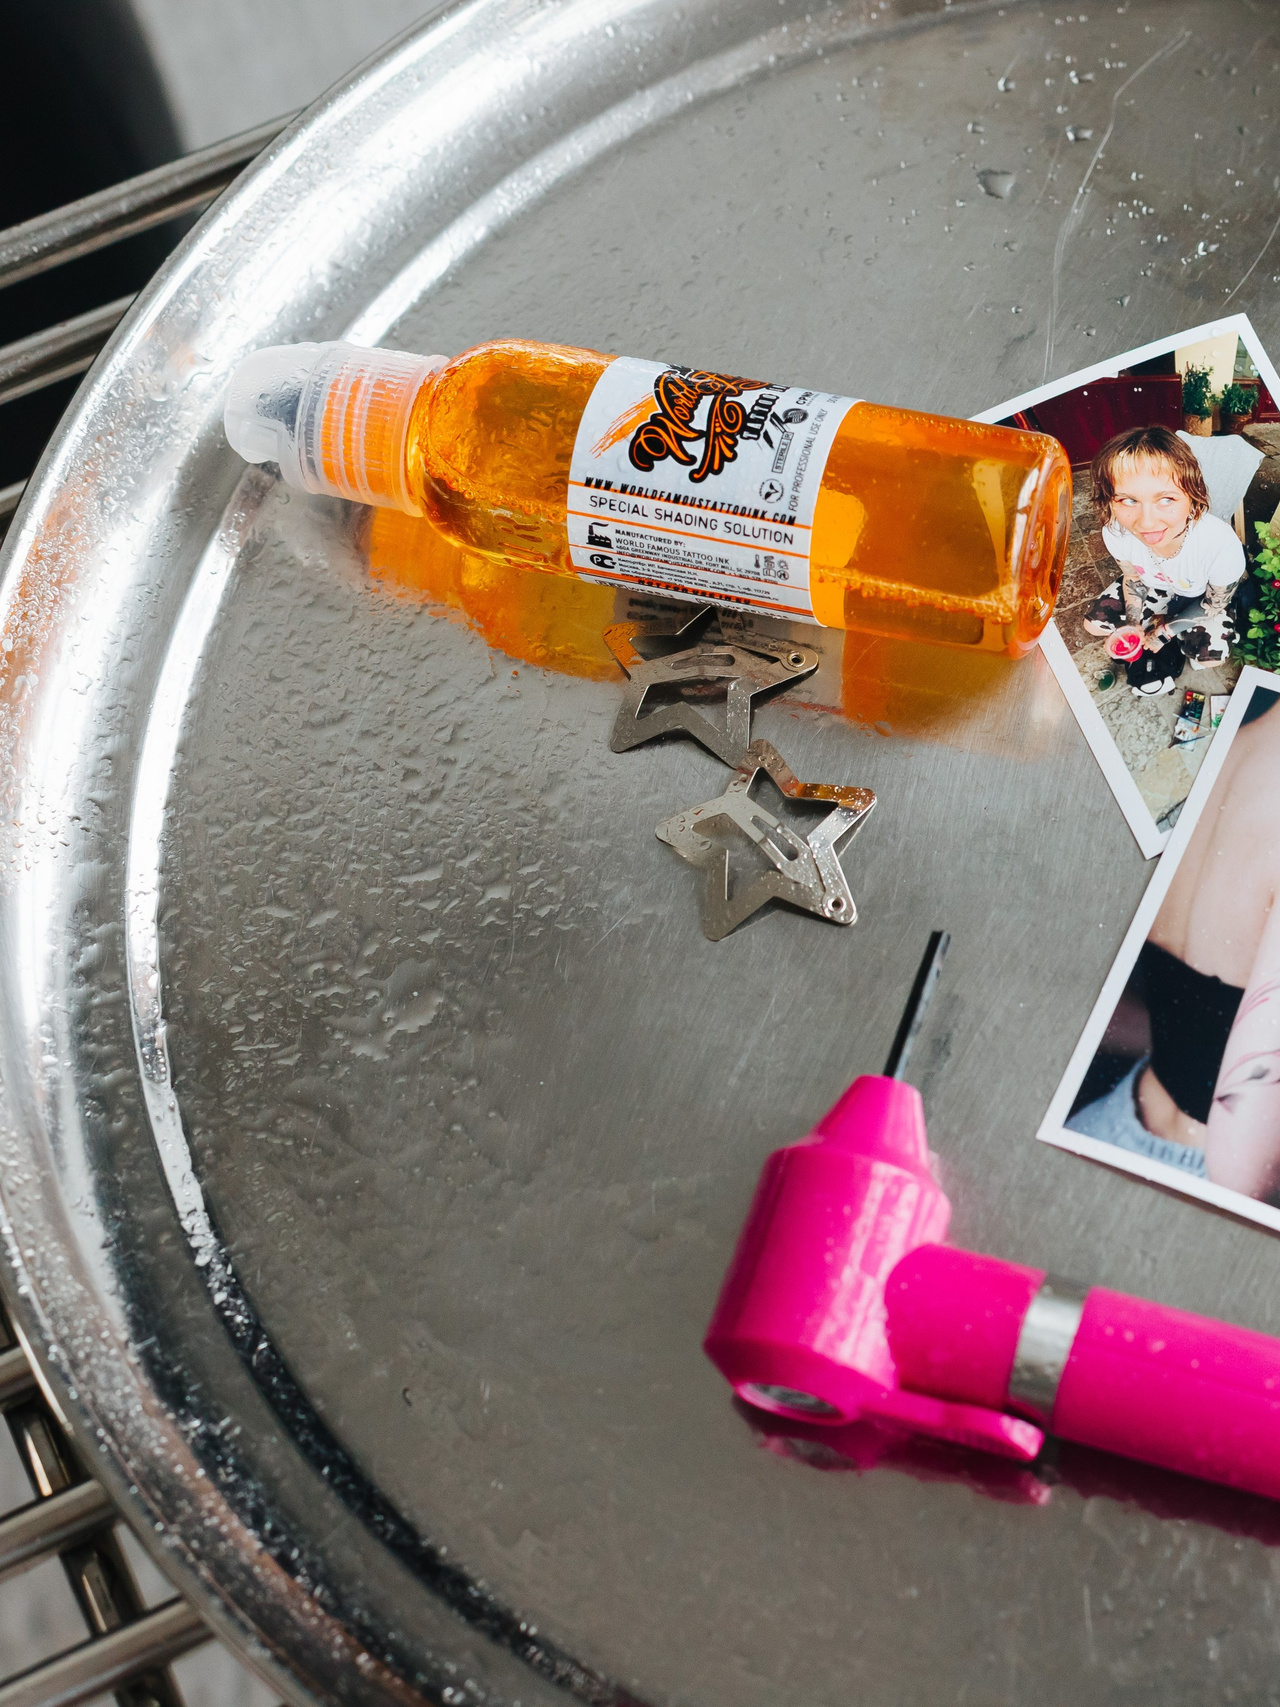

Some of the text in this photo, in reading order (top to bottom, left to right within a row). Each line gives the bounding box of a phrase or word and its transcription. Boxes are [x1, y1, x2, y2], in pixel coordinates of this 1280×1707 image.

[740, 393, 779, 440] TATTOO
[809, 422, 822, 435] USE
[775, 439, 792, 470] STERILE
[792, 434, 816, 493] PROFESSIONAL
[584, 476, 796, 526] WWW.WORLDFAMOUSTATTOOINK.COM
[789, 494, 799, 512] FOR
[589, 495, 794, 545] SPECIAL SHADING SOLUTION
[615, 528, 671, 544] MANUFACTURED
[615, 538, 729, 564] WORLD FAMOUS TATTOO INK
[631, 547, 659, 556] GREENWAY
[661, 553, 693, 563] INDUSTRIAL
